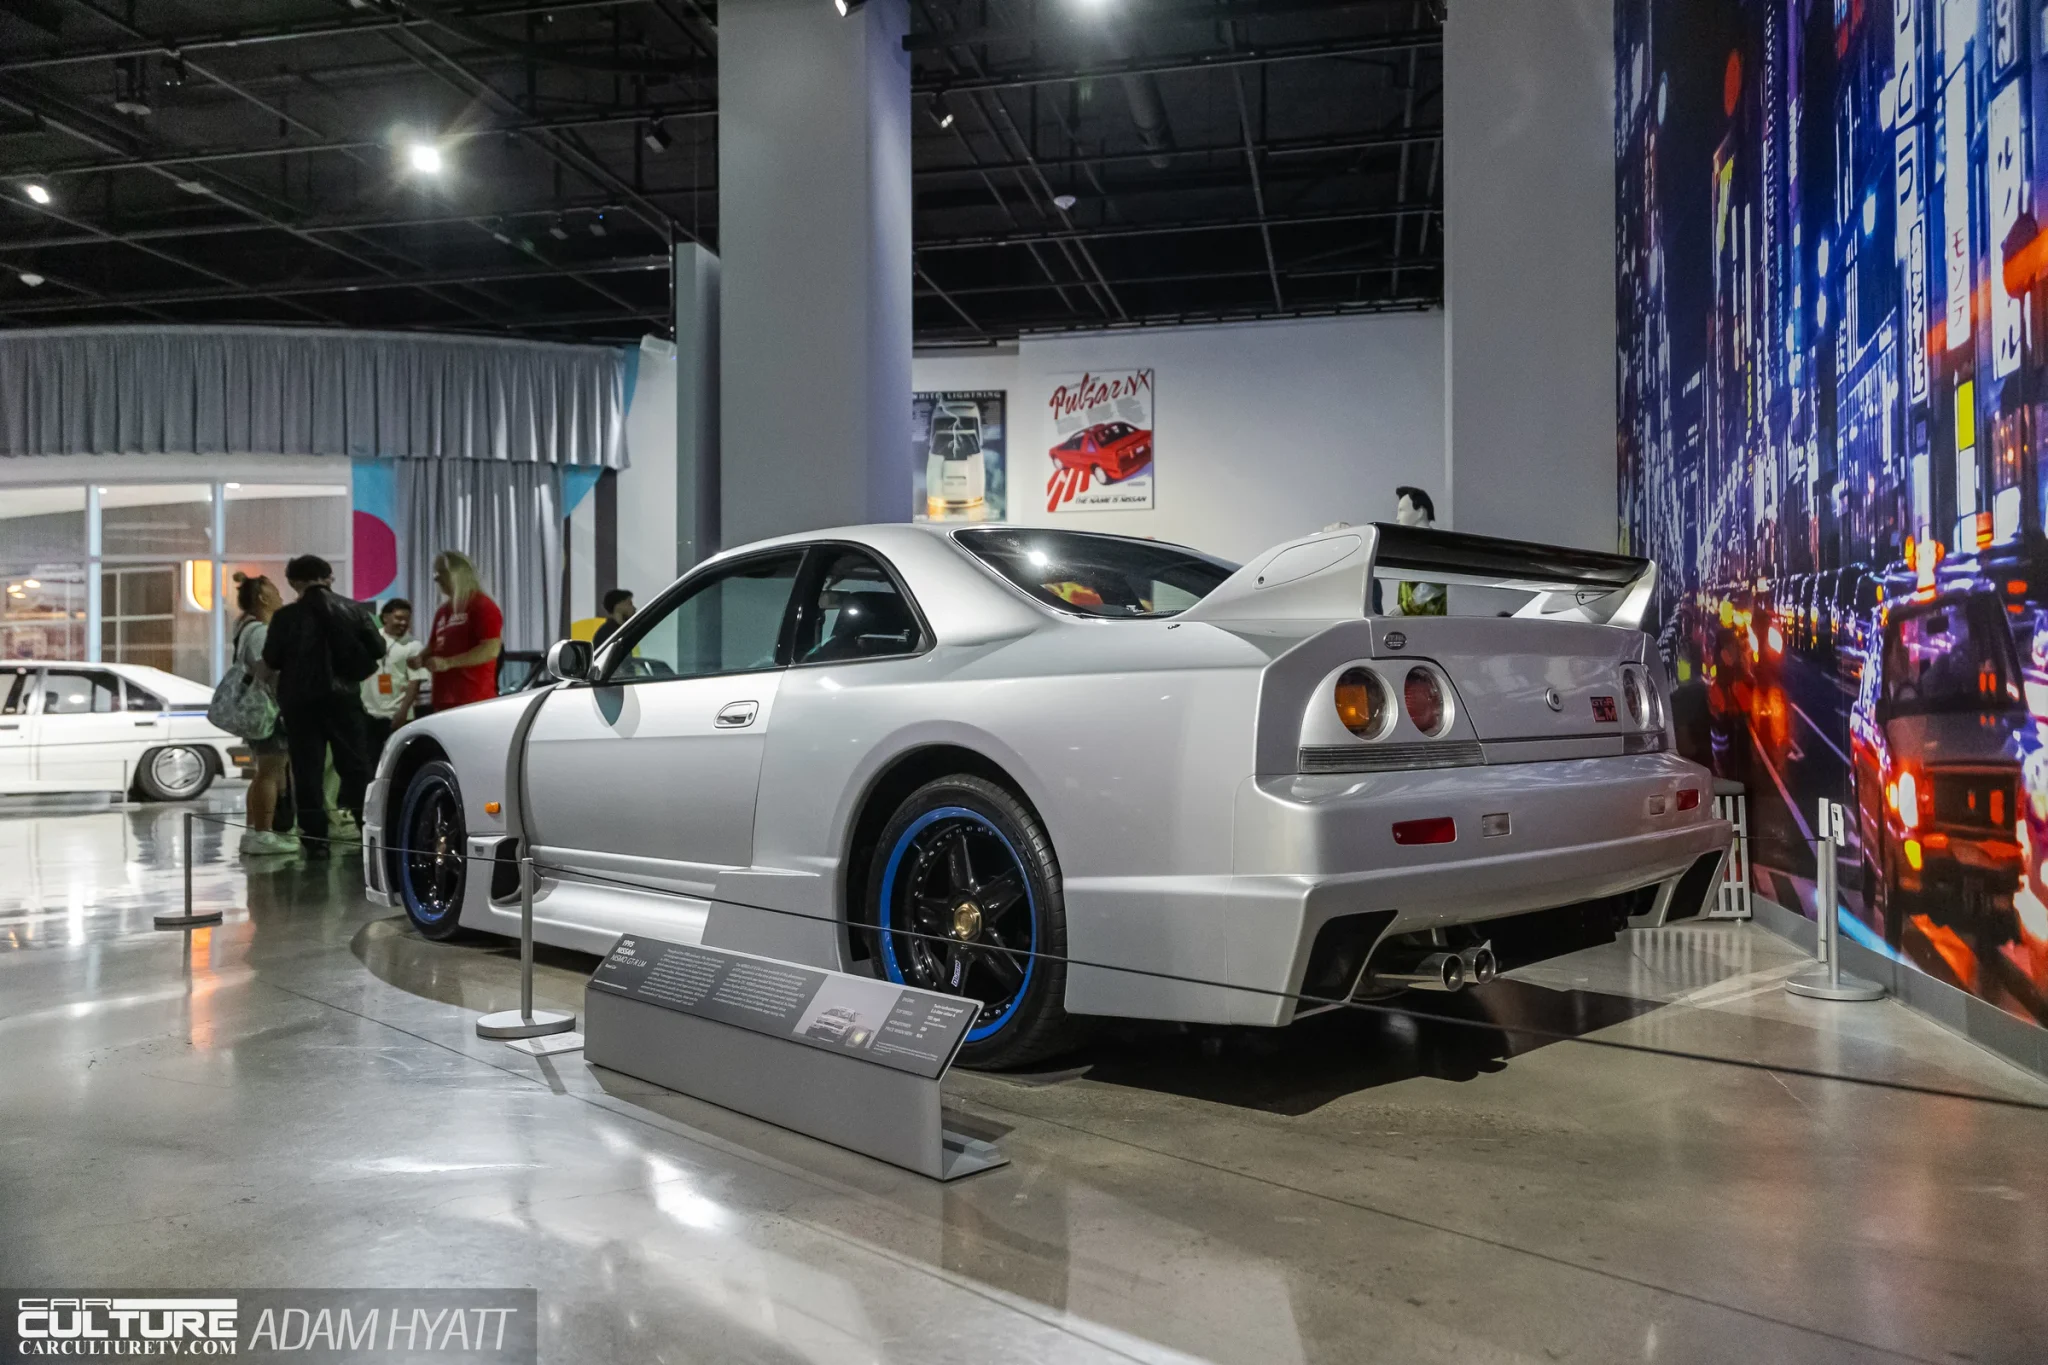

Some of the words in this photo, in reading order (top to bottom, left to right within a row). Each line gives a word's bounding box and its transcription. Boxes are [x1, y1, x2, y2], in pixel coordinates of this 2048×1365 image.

[947, 391, 1001, 400] LIGHTNING
[1049, 372, 1122, 420] Pulsar
[1123, 368, 1151, 396] NX
[1593, 707, 1617, 721] LM
[616, 947, 636, 956] NISSAN
